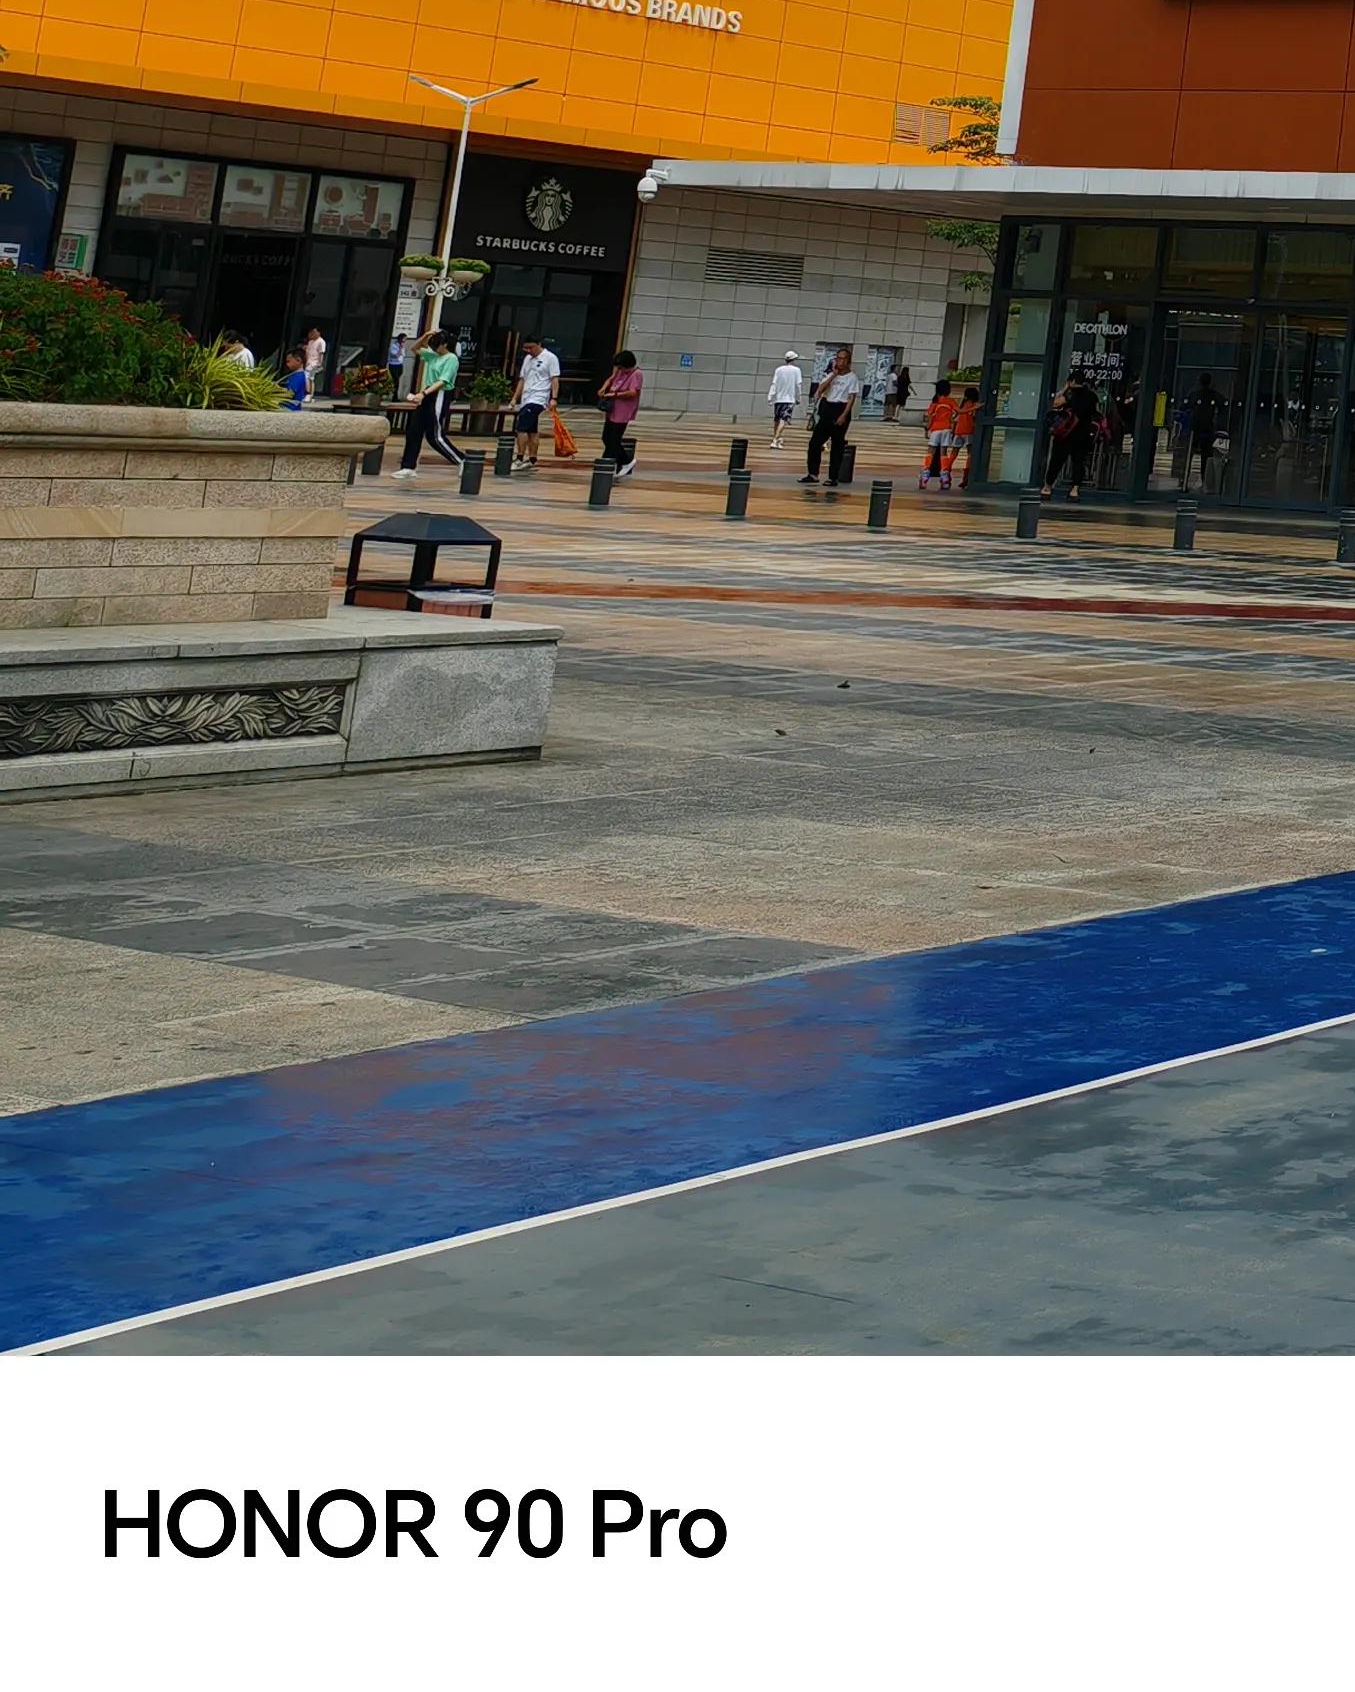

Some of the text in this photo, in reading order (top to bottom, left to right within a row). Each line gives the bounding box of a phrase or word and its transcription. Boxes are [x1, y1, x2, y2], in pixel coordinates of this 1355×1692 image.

[476, 235, 606, 258] STARBUCKS COFFEE
[1073, 322, 1128, 336] DECATHLON
